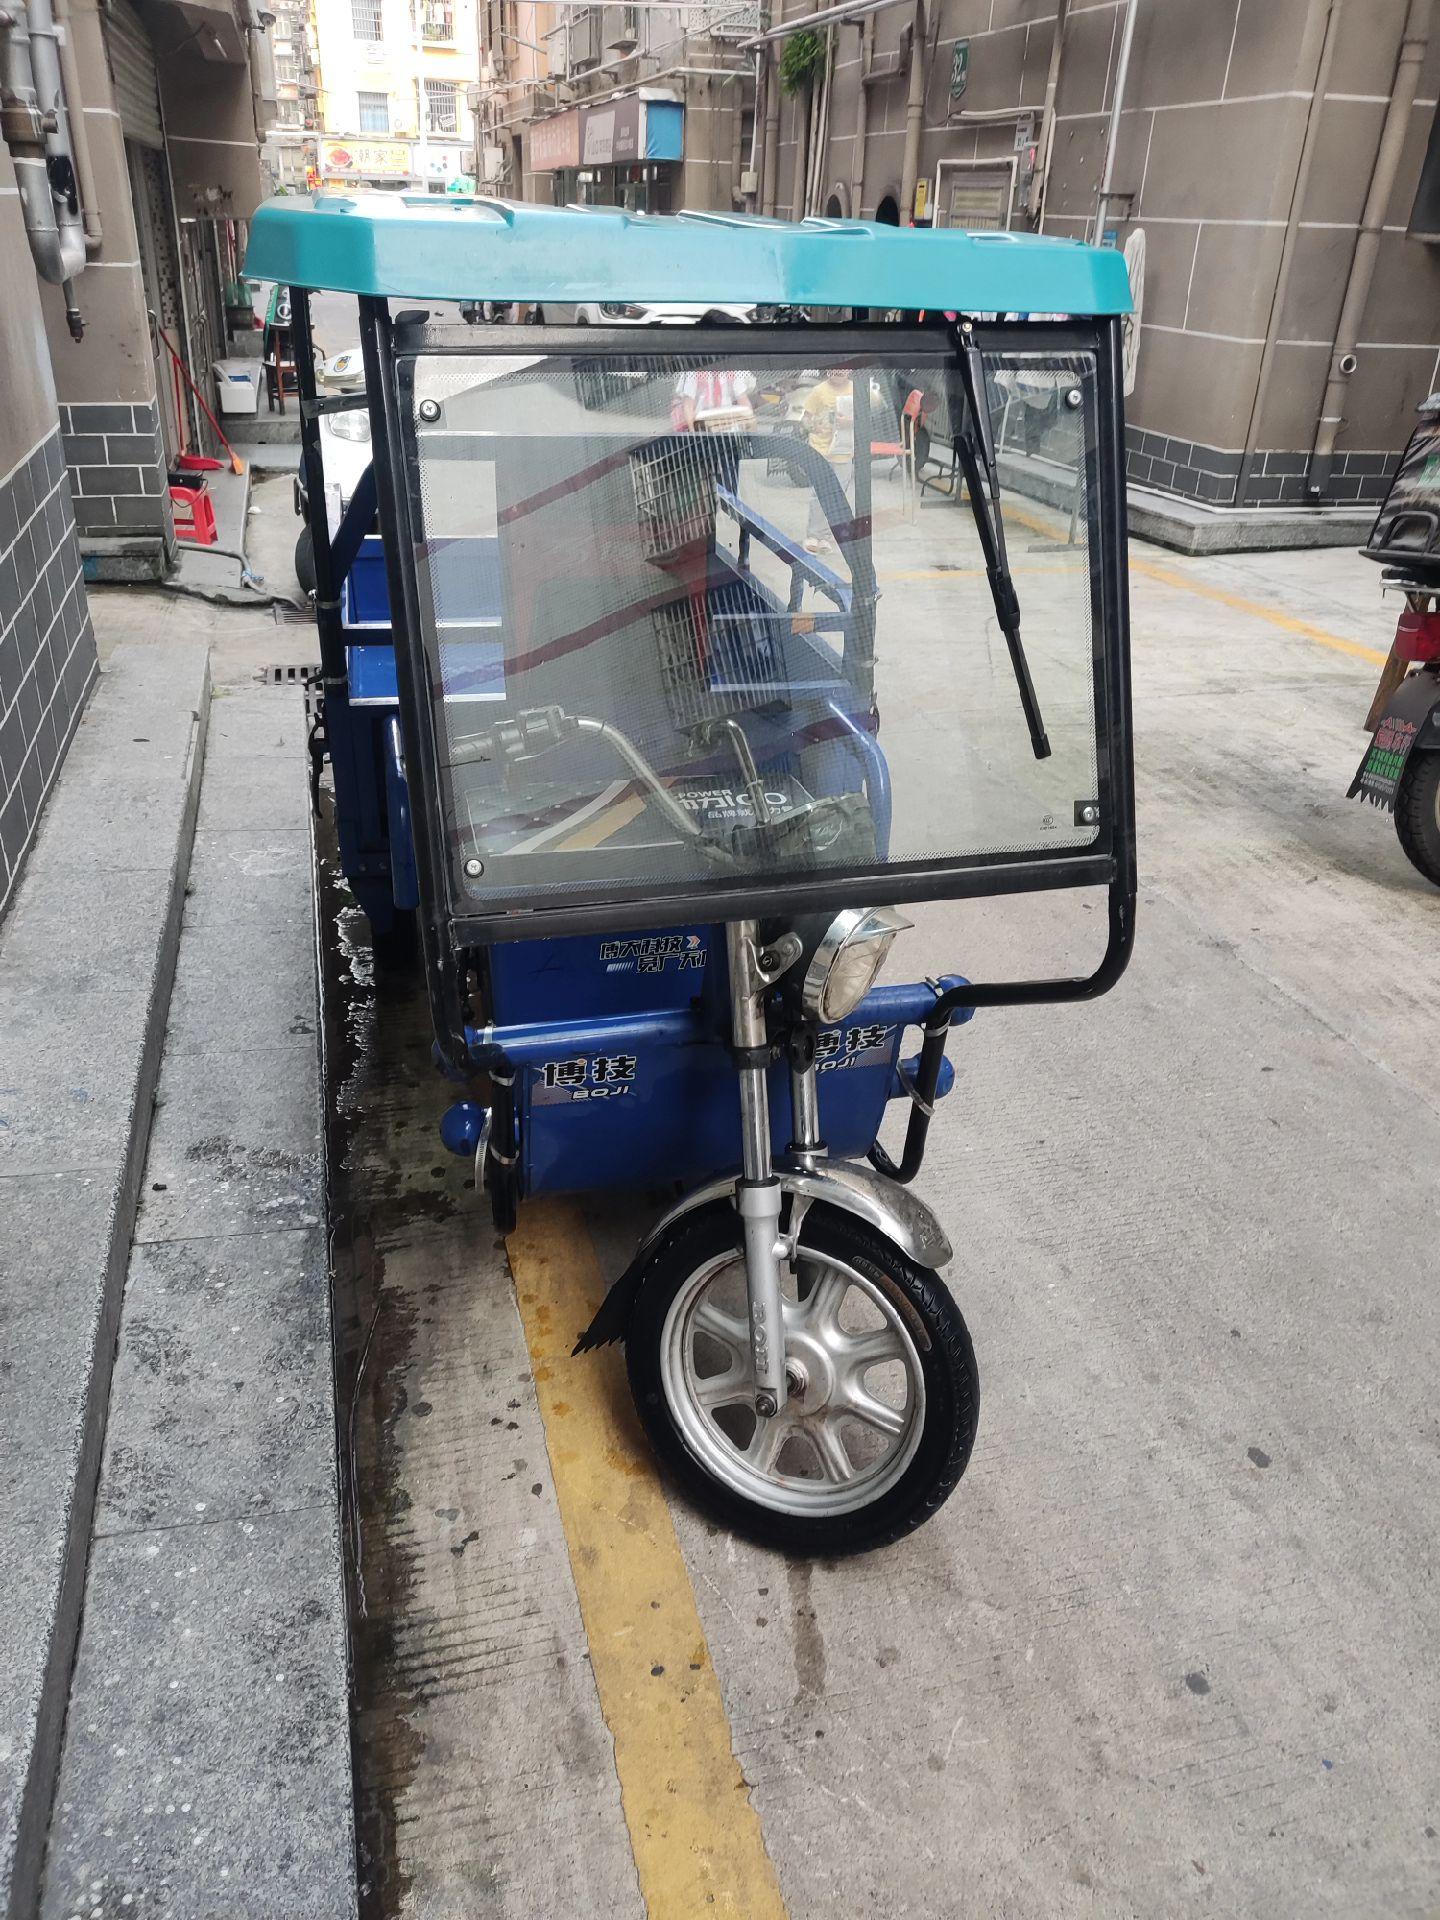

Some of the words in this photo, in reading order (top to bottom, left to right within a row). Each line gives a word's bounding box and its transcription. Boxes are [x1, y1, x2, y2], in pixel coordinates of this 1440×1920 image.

[600, 936, 683, 961] 博大科技
[542, 1055, 637, 1089] 博技
[572, 1085, 629, 1099] BOJI
